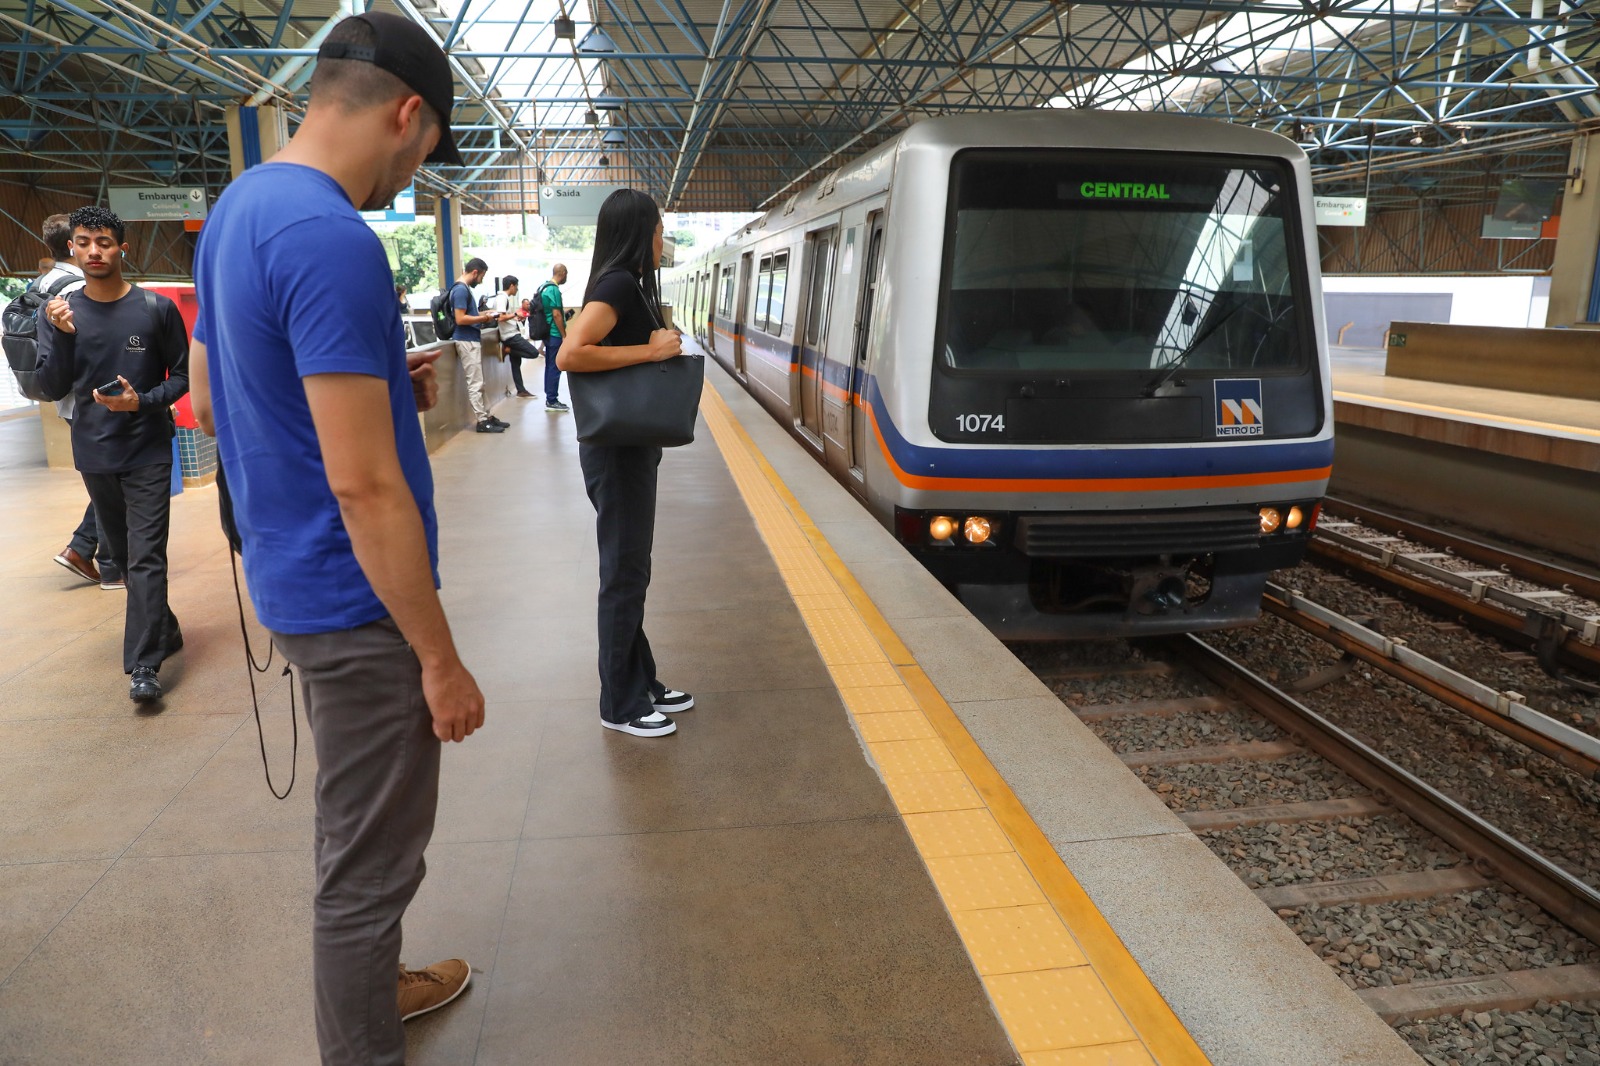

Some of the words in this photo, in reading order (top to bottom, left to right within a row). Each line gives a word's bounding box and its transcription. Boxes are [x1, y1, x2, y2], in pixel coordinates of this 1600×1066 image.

[1080, 182, 1170, 199] CENTRAL
[138, 192, 188, 202] Embarque
[1316, 200, 1353, 210] Embarque
[955, 414, 1005, 432] 1074
[1249, 426, 1262, 435] DF
